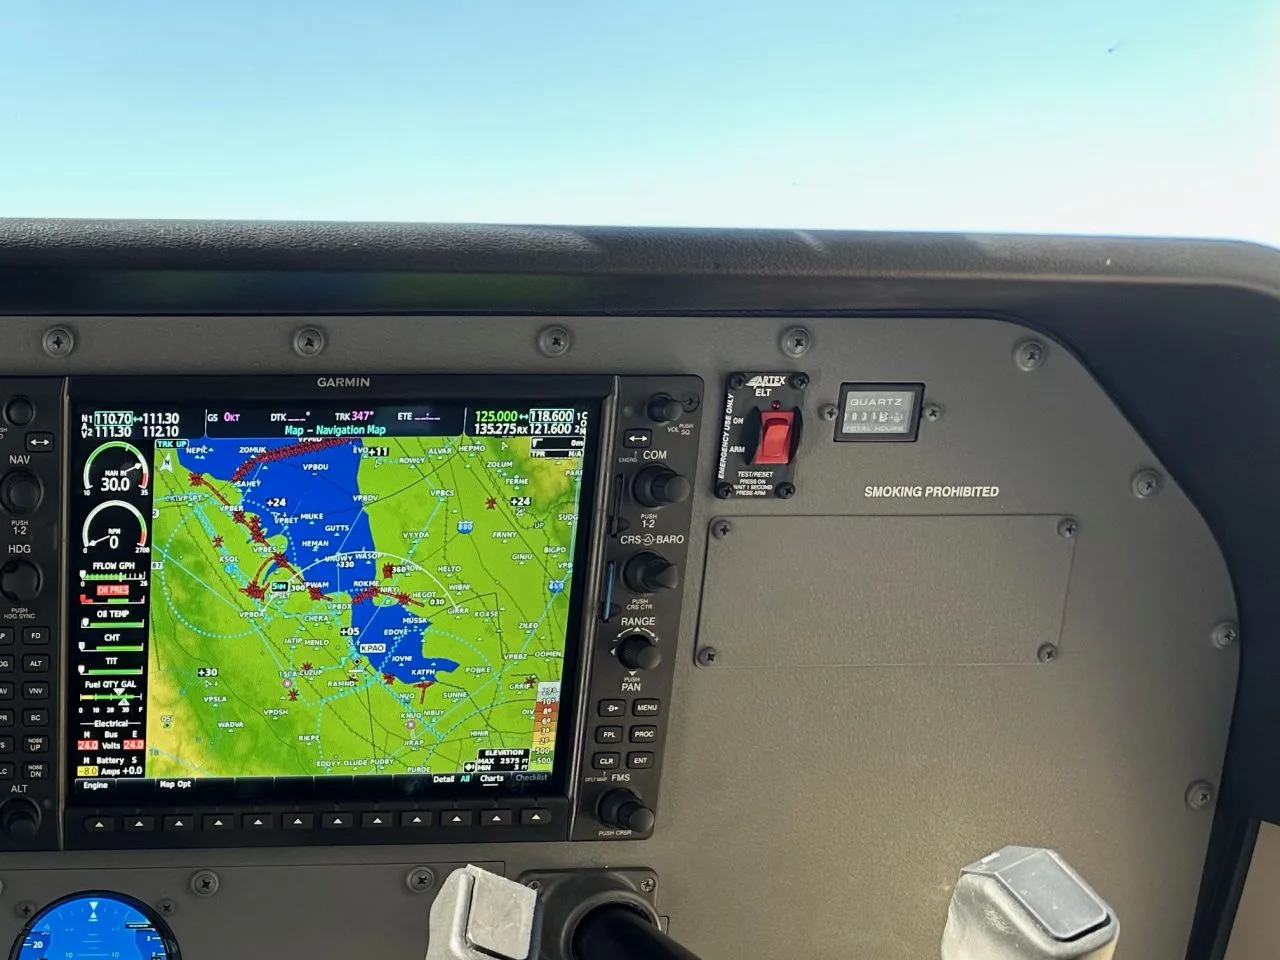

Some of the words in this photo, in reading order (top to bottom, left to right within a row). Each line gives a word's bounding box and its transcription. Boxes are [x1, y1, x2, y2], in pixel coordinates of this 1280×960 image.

[317, 378, 370, 387] GARMIN
[758, 376, 786, 385] ARTEX
[352, 412, 374, 420] 347°
[476, 411, 518, 422] 125.000
[531, 411, 572, 422] 118.600
[285, 426, 304, 436] Map
[316, 426, 364, 436] Navigation
[368, 426, 386, 436] Map
[643, 450, 666, 460] COM
[718, 432, 728, 478] EMERGENCY
[864, 486, 922, 498] SMOKING
[926, 486, 999, 497] PROHIBITED
[120, 562, 134, 570] GPH
[621, 617, 656, 626] RANGE
[84, 782, 108, 790] Engine
